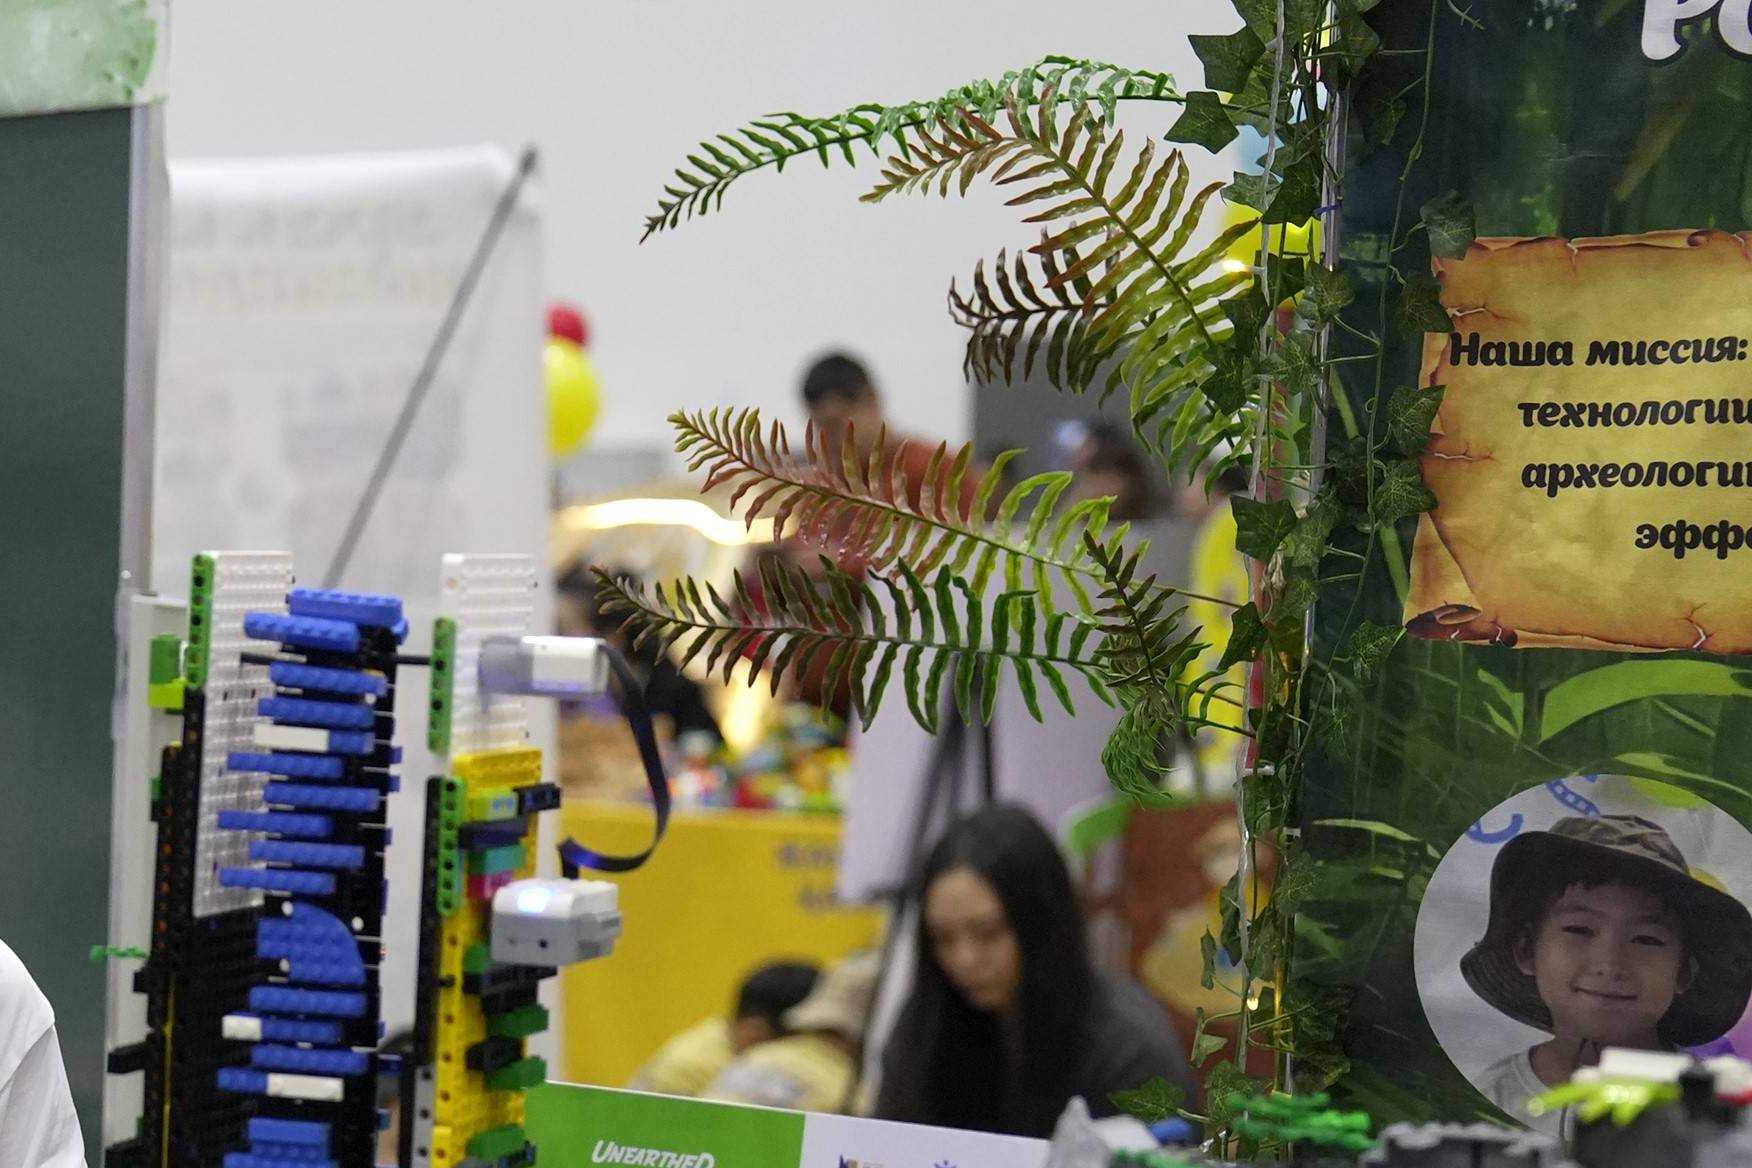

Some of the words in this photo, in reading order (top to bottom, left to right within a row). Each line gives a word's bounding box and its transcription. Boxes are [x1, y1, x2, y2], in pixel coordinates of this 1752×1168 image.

[1449, 331, 1574, 367] Наша
[1585, 336, 1749, 366] миссия:
[1521, 461, 1752, 497] археологи
[1635, 519, 1752, 560] эфф
